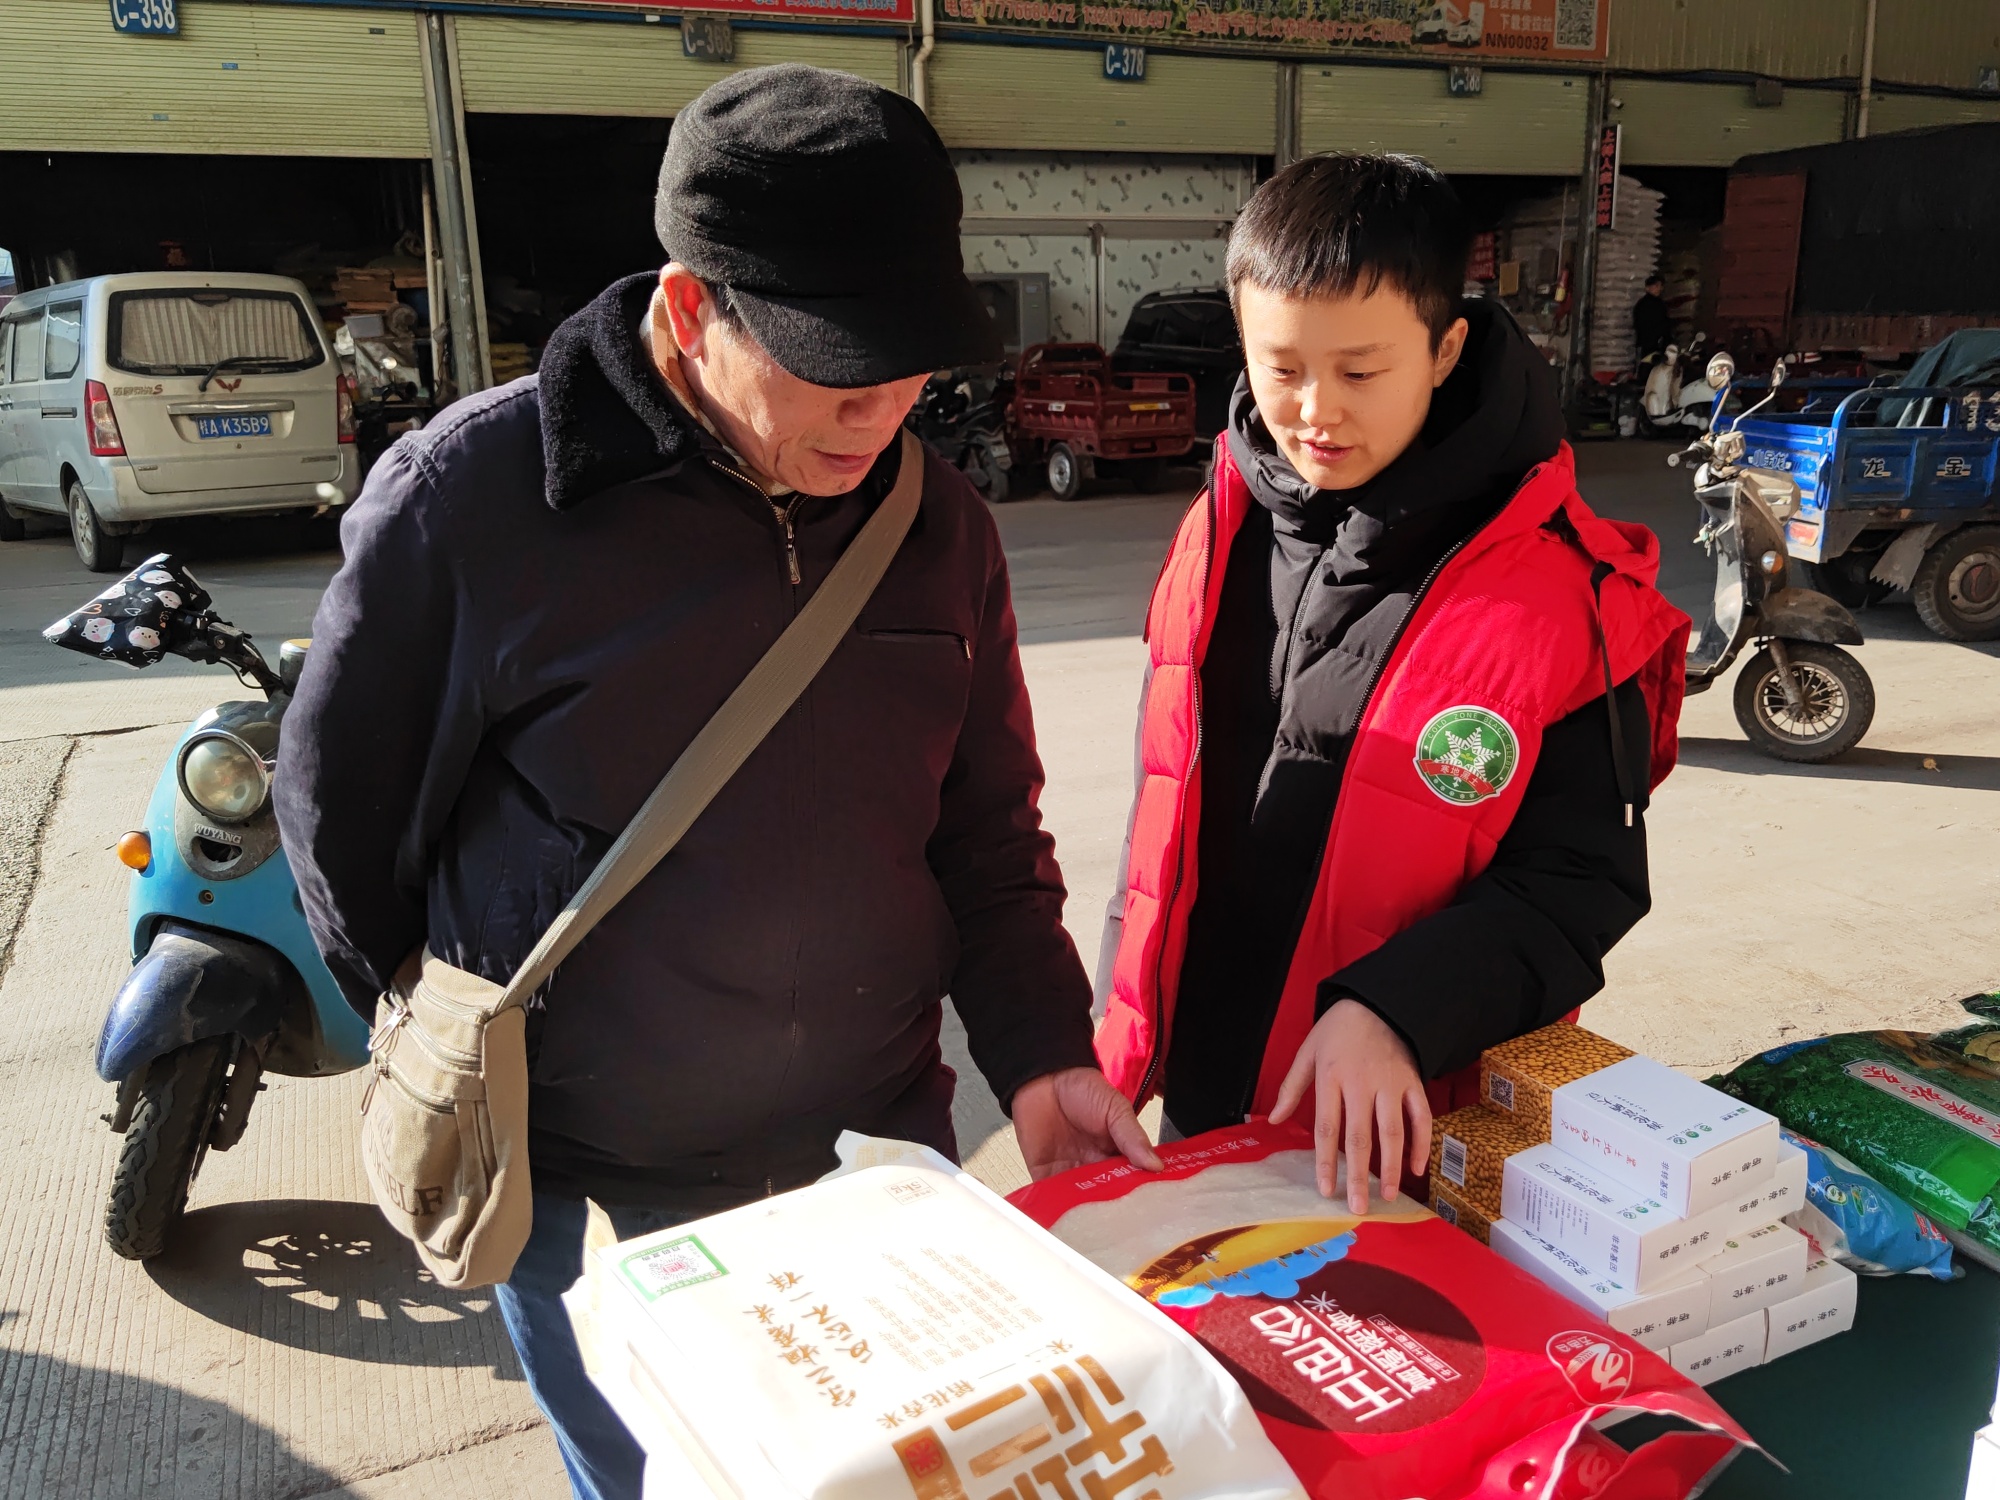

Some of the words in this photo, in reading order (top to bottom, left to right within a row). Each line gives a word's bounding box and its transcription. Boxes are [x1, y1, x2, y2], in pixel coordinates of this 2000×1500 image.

[113, 0, 175, 29] C-358
[1485, 33, 1548, 51] NN00032
[1106, 44, 1145, 76] C-378
[1864, 457, 1886, 477] 龙
[1943, 456, 1966, 477] 金
[1428, 719, 1447, 739] COLD
[1454, 712, 1478, 720] ZONE
[1484, 716, 1508, 738] BLACK
[1440, 764, 1479, 786] 寒地黑土
[194, 823, 242, 844] WUYANG
[1585, 1092, 1665, 1129] 海伦富硒大豆
[1074, 1136, 1261, 1191] 黑龙江硒谷米有限公司
[1712, 1157, 1762, 1186] 硒都·海伦
[1539, 1161, 1614, 1205] 海伦富硒大豆
[1659, 1161, 1670, 1199] 非转基因
[1738, 1186, 1789, 1213] 硒都·海伦
[1608, 1233, 1620, 1273] 非转基因
[1660, 1230, 1710, 1260] 硒都·海伦
[1731, 1272, 1789, 1300] 硒都·海伦
[766, 1271, 873, 1364] 反正不一样
[1786, 1306, 1838, 1333] 硒都·海伦
[1303, 1290, 1438, 1393] 富硒稻香米
[1249, 1303, 1405, 1423] 五色谷
[1690, 1343, 1745, 1371] 硒都·海伦
[876, 1378, 976, 1430] 稻花香米
